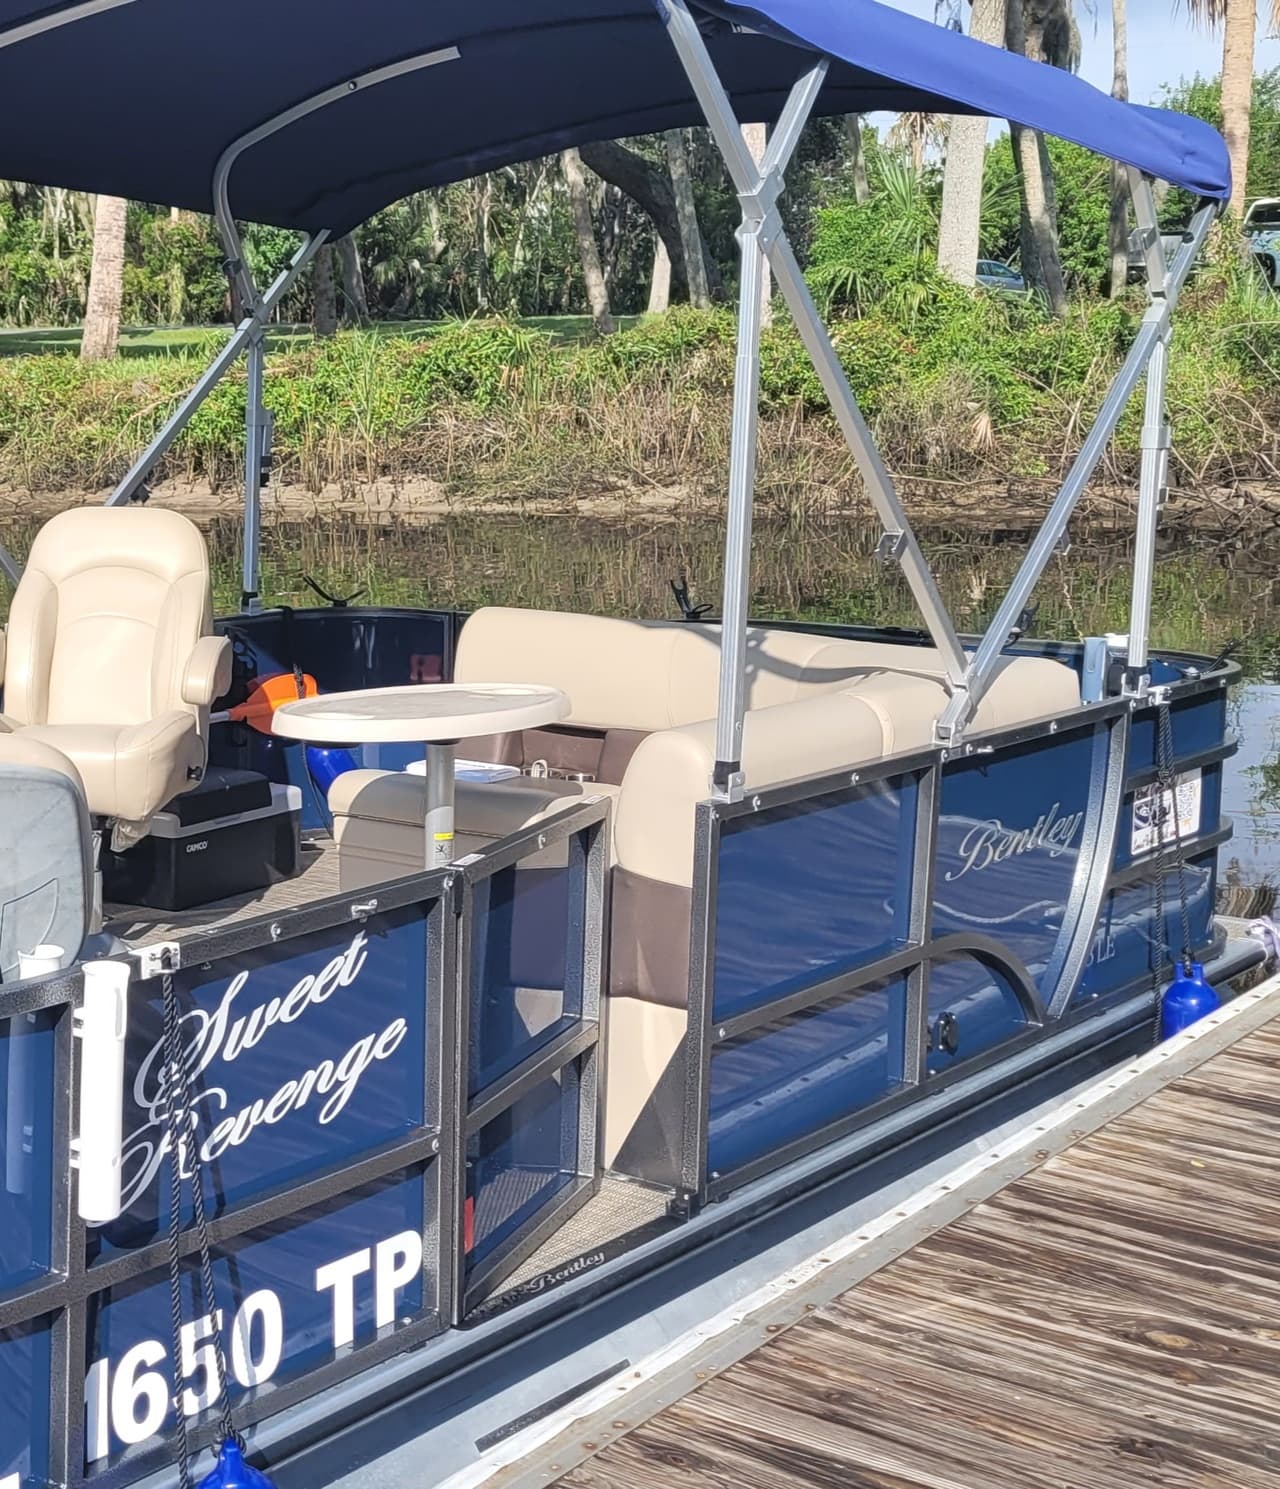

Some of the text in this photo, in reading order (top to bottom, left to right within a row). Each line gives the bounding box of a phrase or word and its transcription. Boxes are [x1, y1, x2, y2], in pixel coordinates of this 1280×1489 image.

[944, 802, 1084, 881] Bentley
[134, 930, 368, 1109] Sweet
[113, 1018, 408, 1212] Revenge
[84, 1288, 283, 1462] 1650
[316, 1229, 423, 1347] TP
[530, 1252, 605, 1293] Bentley
